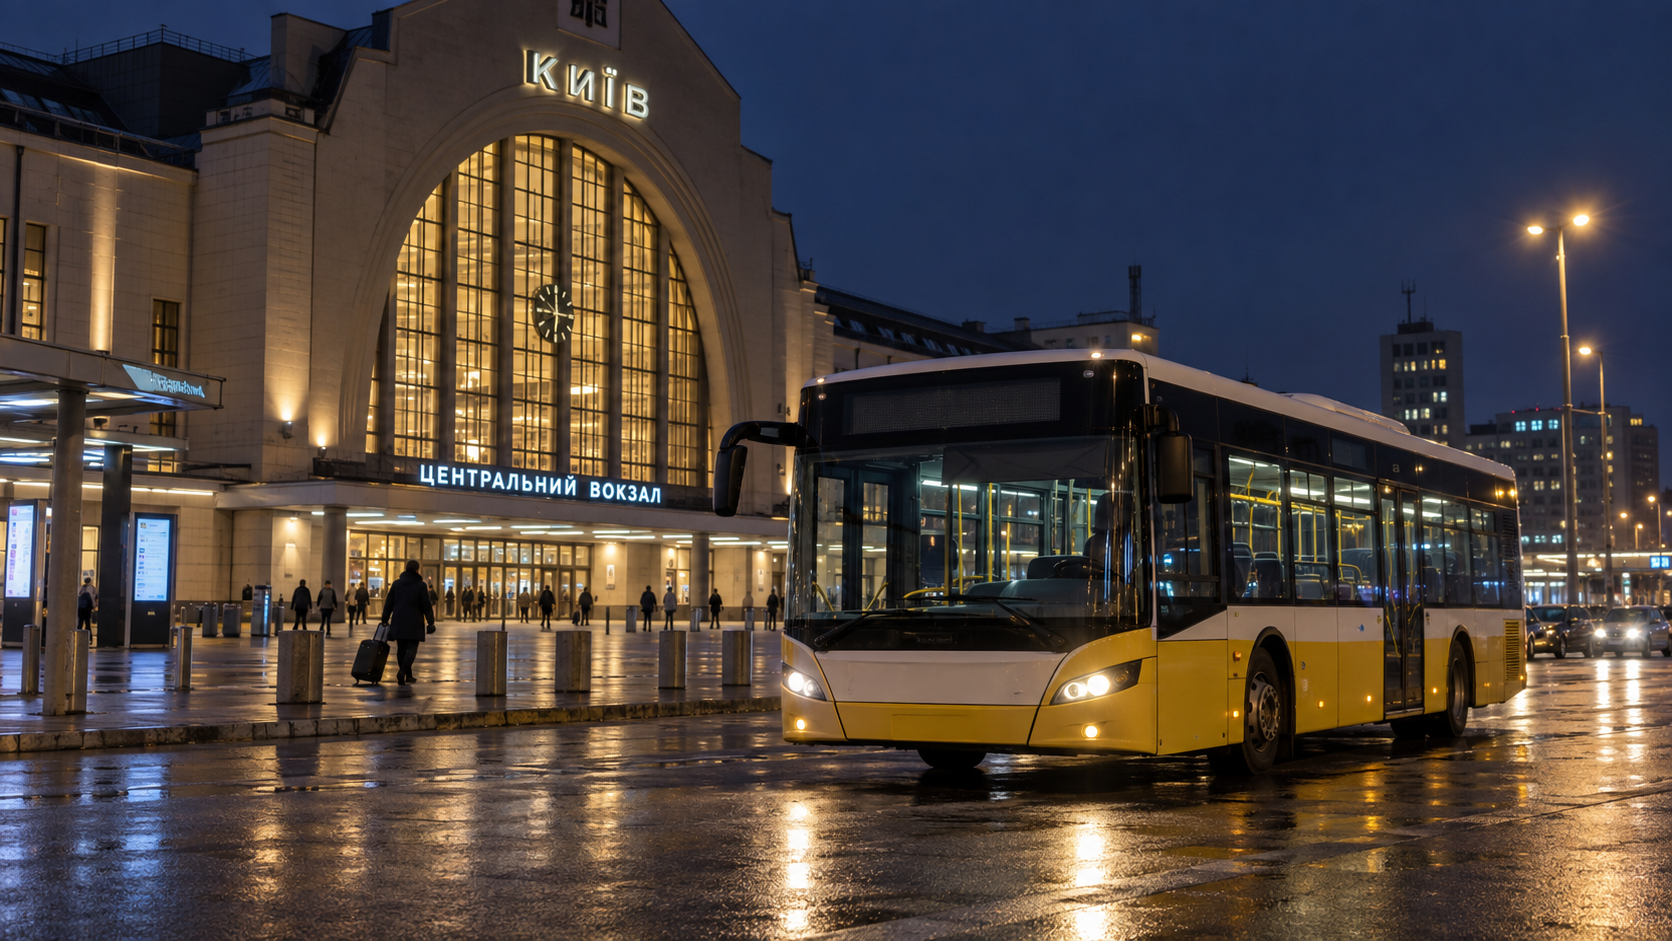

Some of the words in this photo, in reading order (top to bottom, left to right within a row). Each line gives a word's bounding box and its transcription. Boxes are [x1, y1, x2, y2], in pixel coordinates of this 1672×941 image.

[524, 49, 650, 119] КИЇВ
[420, 464, 577, 496] ЦЕНТРАЛЬНИЙ
[590, 481, 661, 503] ВОКЗАЛ
